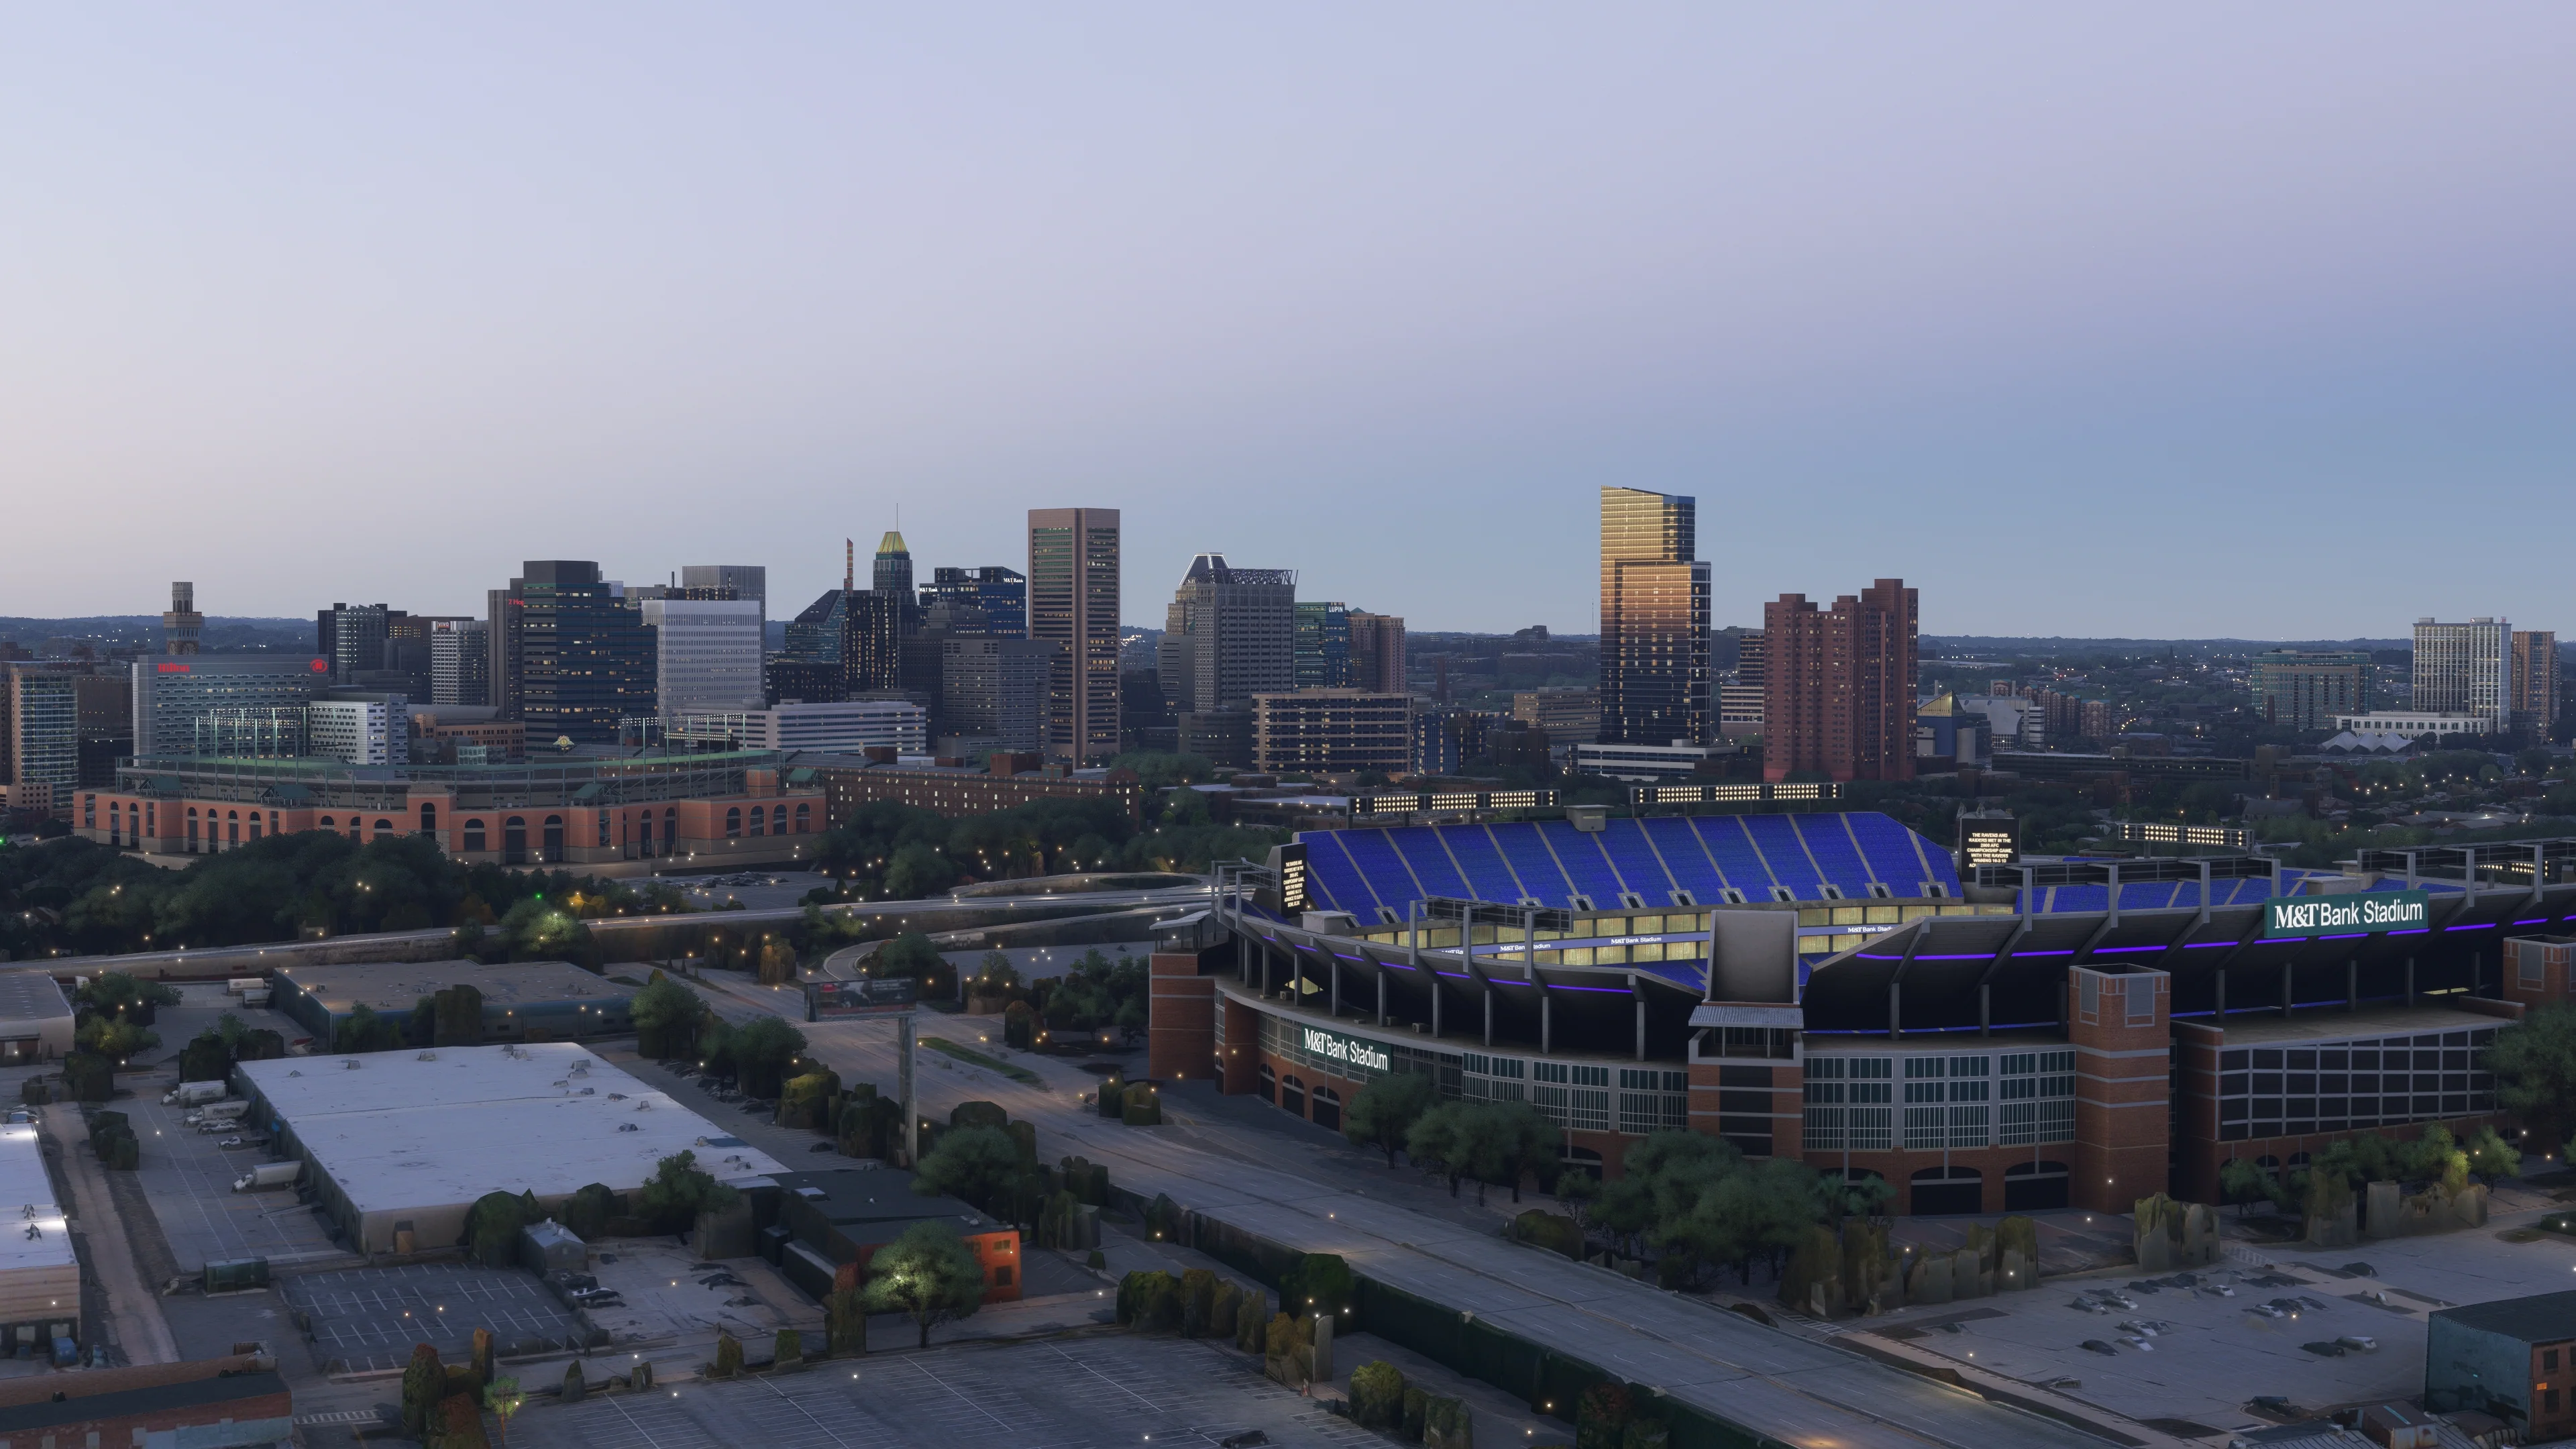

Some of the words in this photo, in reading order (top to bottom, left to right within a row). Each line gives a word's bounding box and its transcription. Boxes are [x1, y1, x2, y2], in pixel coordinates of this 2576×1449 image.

[158, 662, 190, 673] Hilton
[2275, 904, 2319, 928] M&T
[2320, 902, 2359, 926] Bank
[2363, 899, 2422, 924] Stadium
[1304, 1028, 1326, 1054] M&T
[1326, 1034, 1348, 1061] Bank
[1350, 1040, 1388, 1071] Stadium
